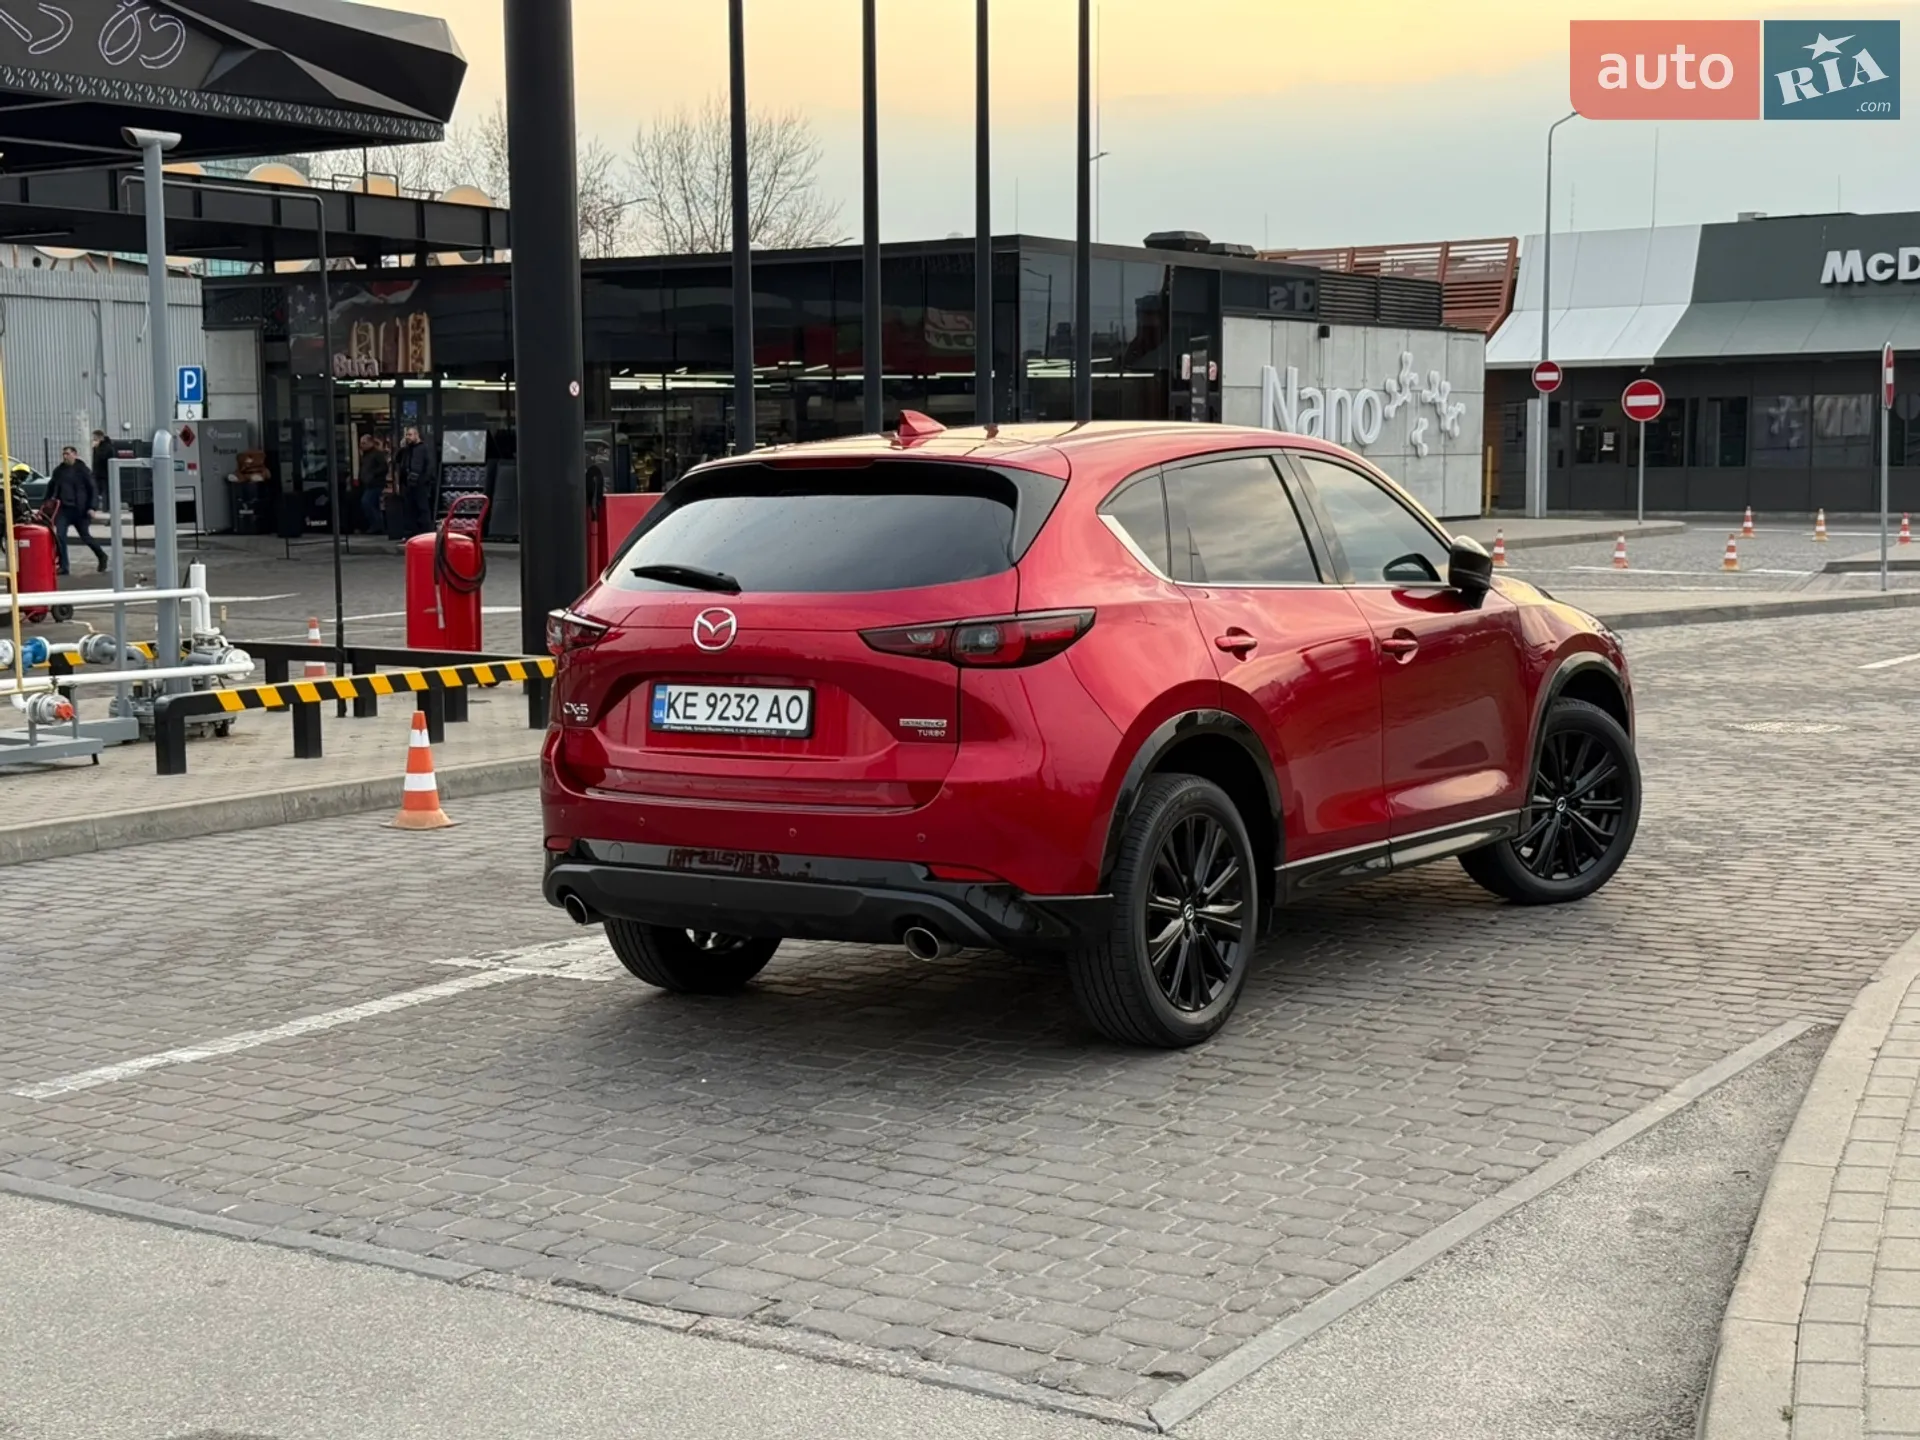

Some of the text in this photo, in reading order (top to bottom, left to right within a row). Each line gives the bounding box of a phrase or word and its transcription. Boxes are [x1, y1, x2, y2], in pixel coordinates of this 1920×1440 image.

[1820, 247, 1920, 284] McD
[183, 370, 197, 399] P
[1261, 364, 1383, 445] Nano
[563, 702, 590, 715] CX-5
[666, 691, 804, 724] KE 9232 AO
